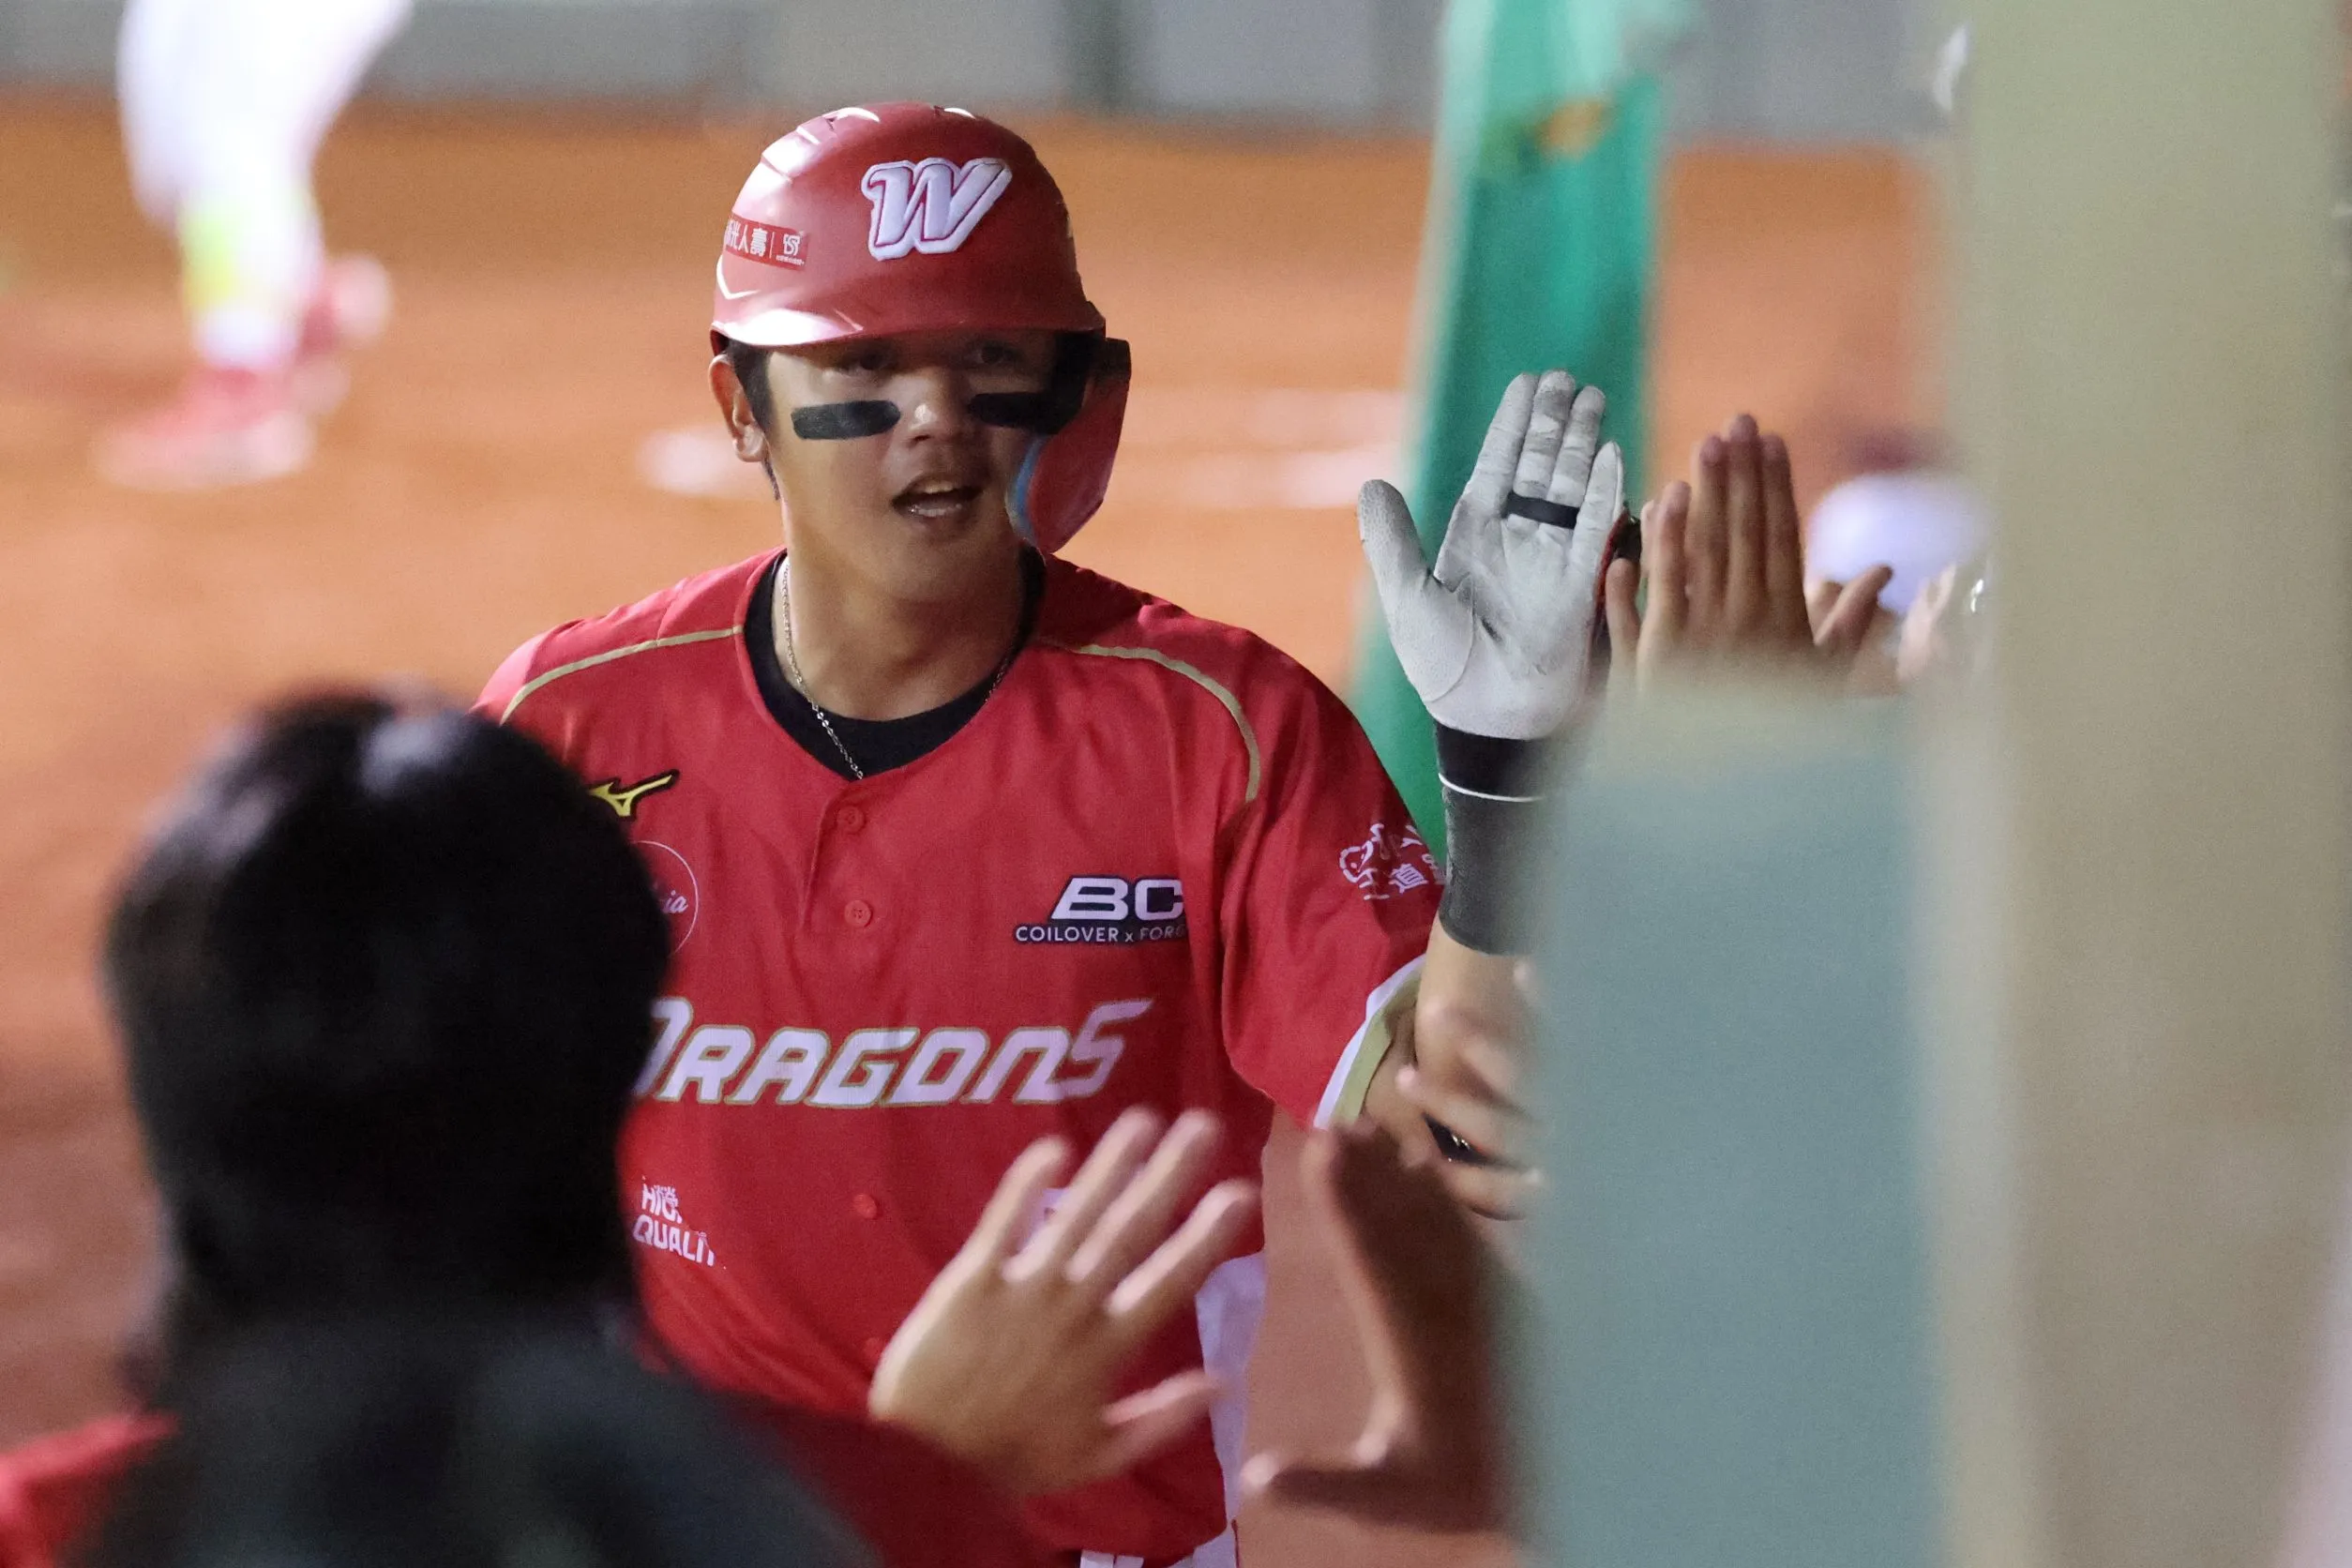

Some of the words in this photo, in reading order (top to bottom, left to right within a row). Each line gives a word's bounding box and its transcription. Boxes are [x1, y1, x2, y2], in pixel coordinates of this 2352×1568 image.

[861, 158, 1013, 261] W
[1050, 878, 1184, 921] BC
[1016, 926, 1119, 942] COILOVER
